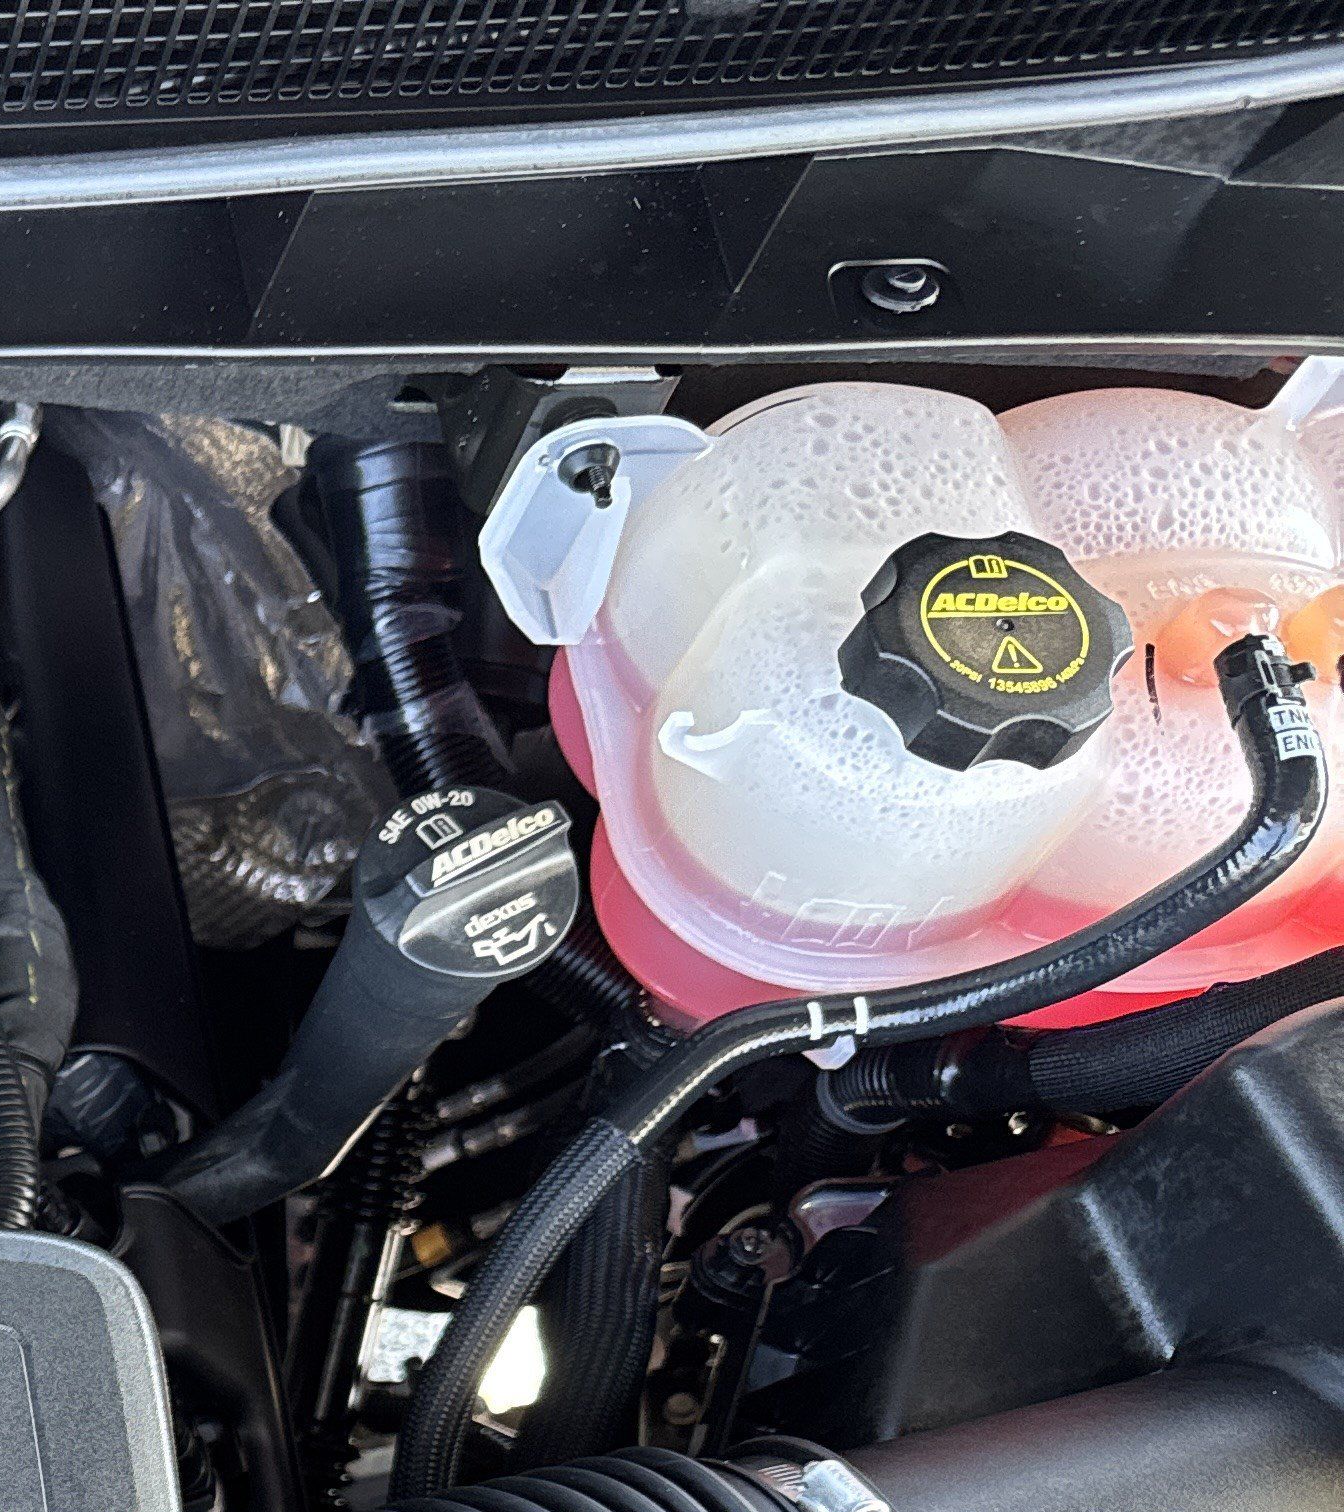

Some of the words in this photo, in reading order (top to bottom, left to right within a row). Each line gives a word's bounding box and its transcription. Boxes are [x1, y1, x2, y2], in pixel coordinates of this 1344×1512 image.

[930, 592, 1070, 612] ACDelco
[378, 809, 414, 845] SAE
[410, 789, 475, 815] 0W-20
[430, 807, 556, 883] ACDelco
[464, 891, 537, 938] dexos
